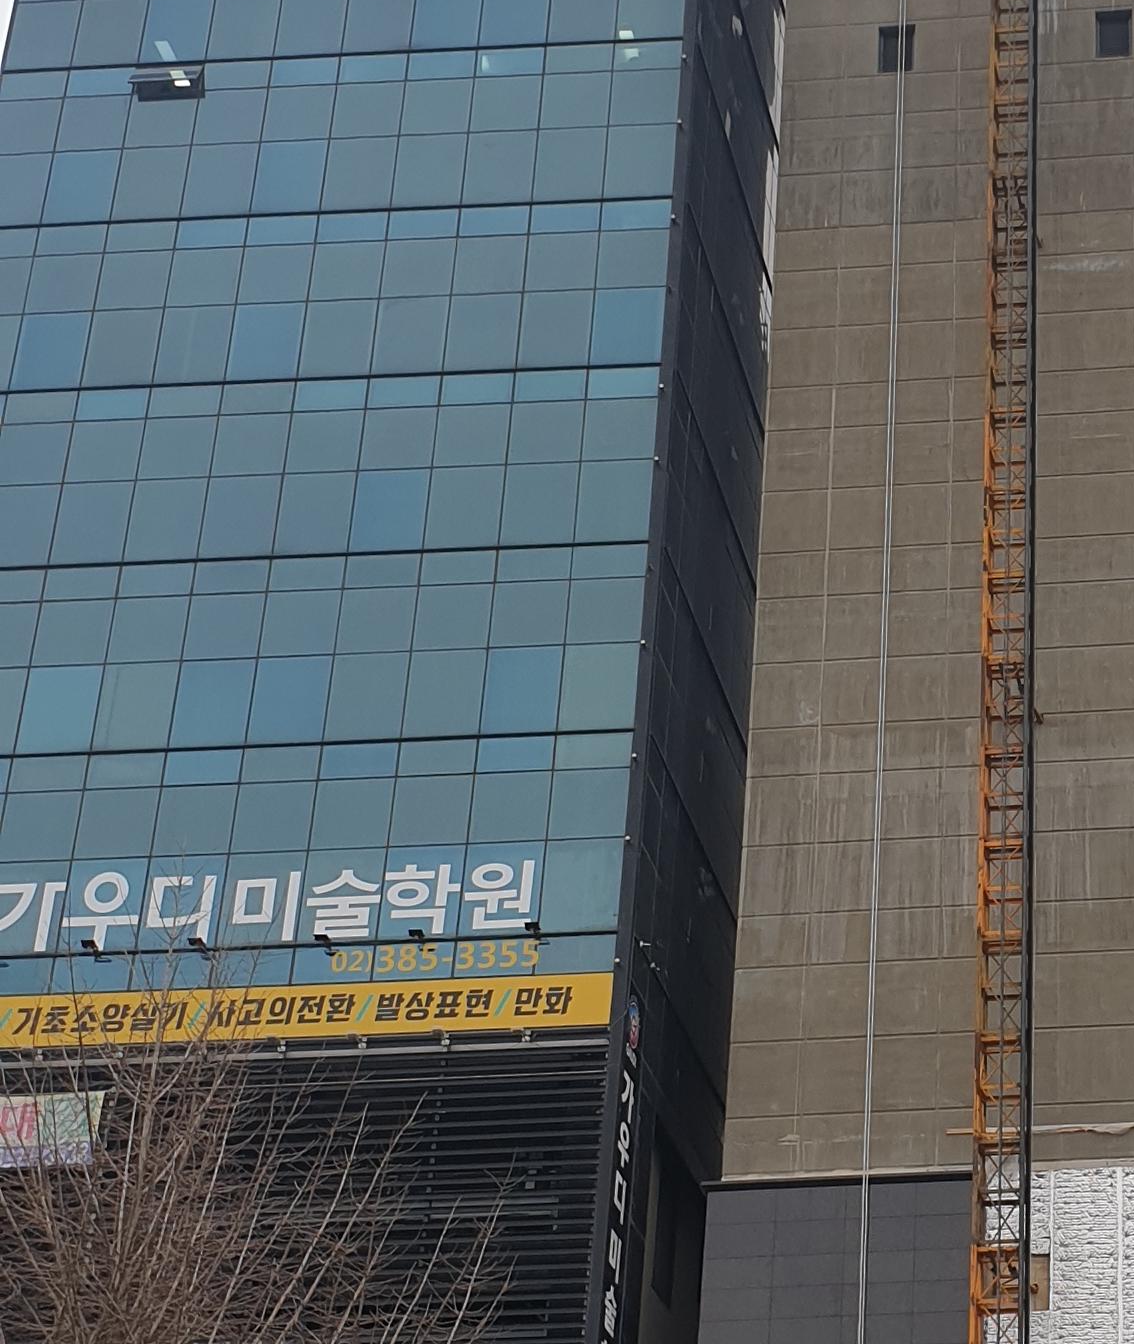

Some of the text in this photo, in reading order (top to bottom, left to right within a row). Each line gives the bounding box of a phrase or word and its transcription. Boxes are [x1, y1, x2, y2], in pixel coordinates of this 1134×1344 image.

[0, 860, 535, 953] 가우디미술학원
[331, 940, 540, 973] 02)385-3355
[208, 993, 356, 1029] 사고의전환
[374, 988, 494, 1023] 발상표현
[514, 986, 573, 1016] 만화
